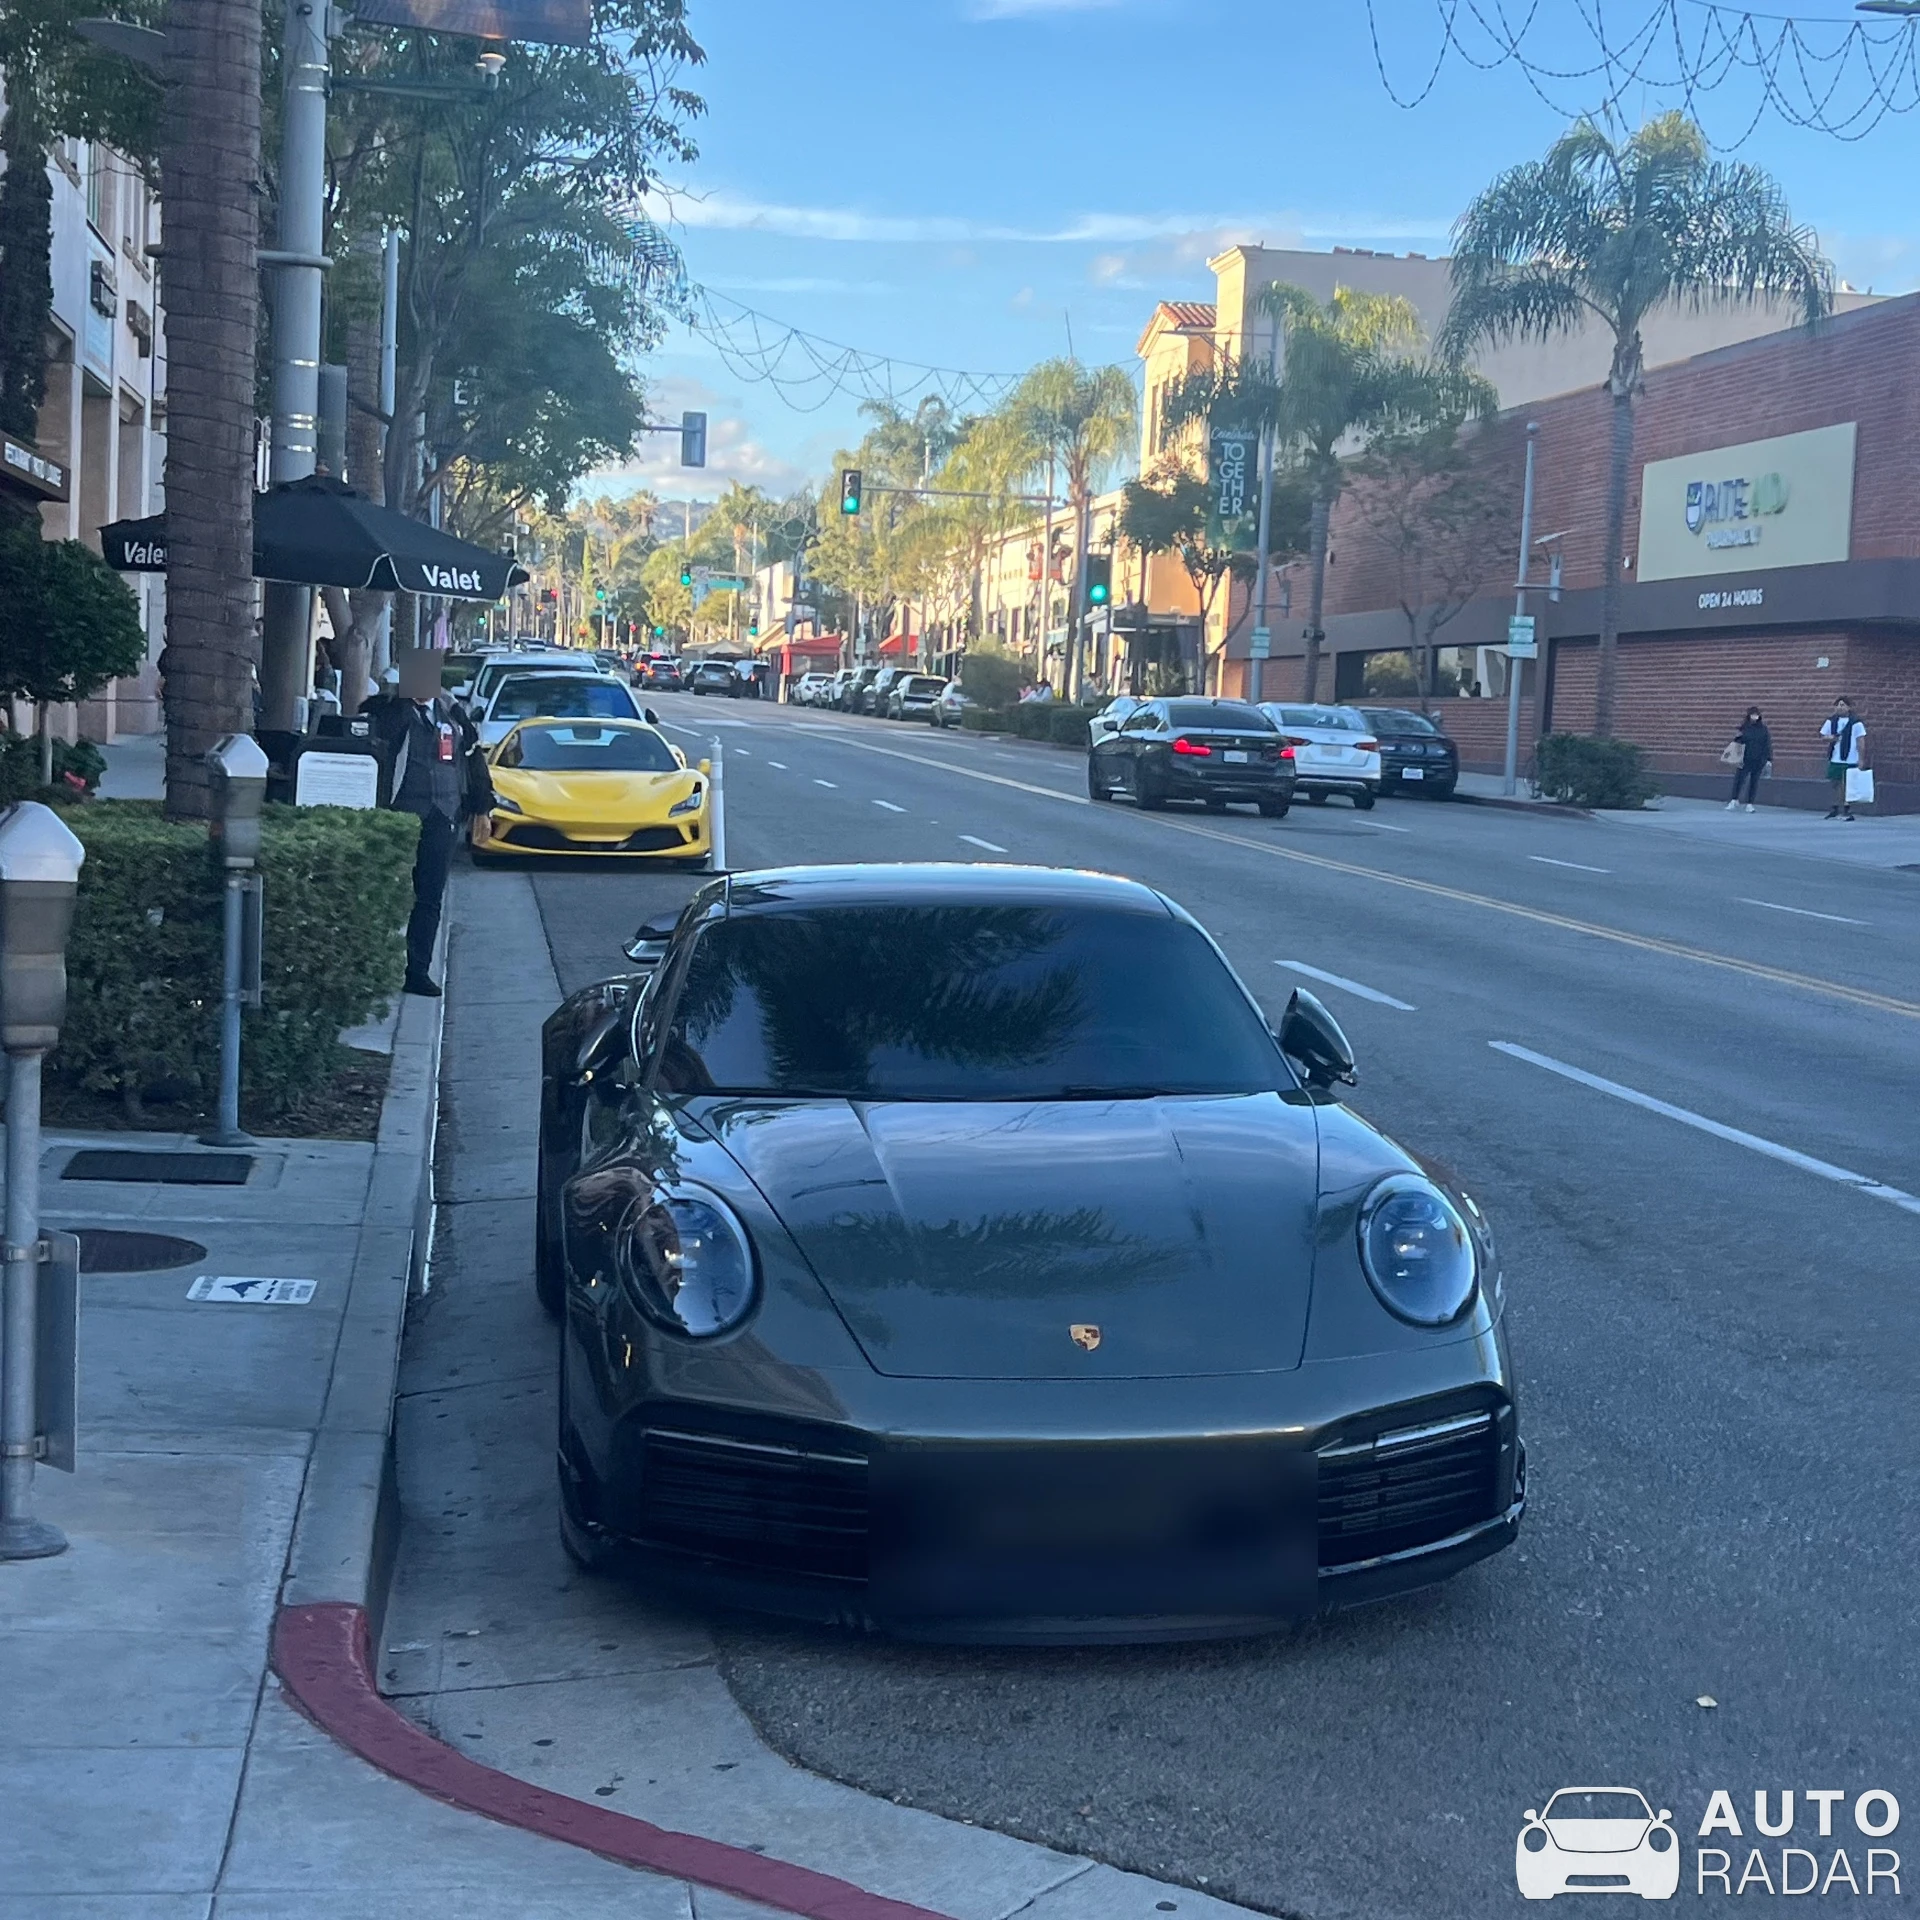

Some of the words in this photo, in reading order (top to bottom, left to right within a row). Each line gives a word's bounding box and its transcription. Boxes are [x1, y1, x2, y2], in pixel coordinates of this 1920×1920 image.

[1702, 478, 1750, 522] RITE
[421, 564, 483, 591] Valet
[1698, 592, 1721, 609] OPEN
[1721, 591, 1733, 608] 24
[1733, 588, 1763, 606] HOURS
